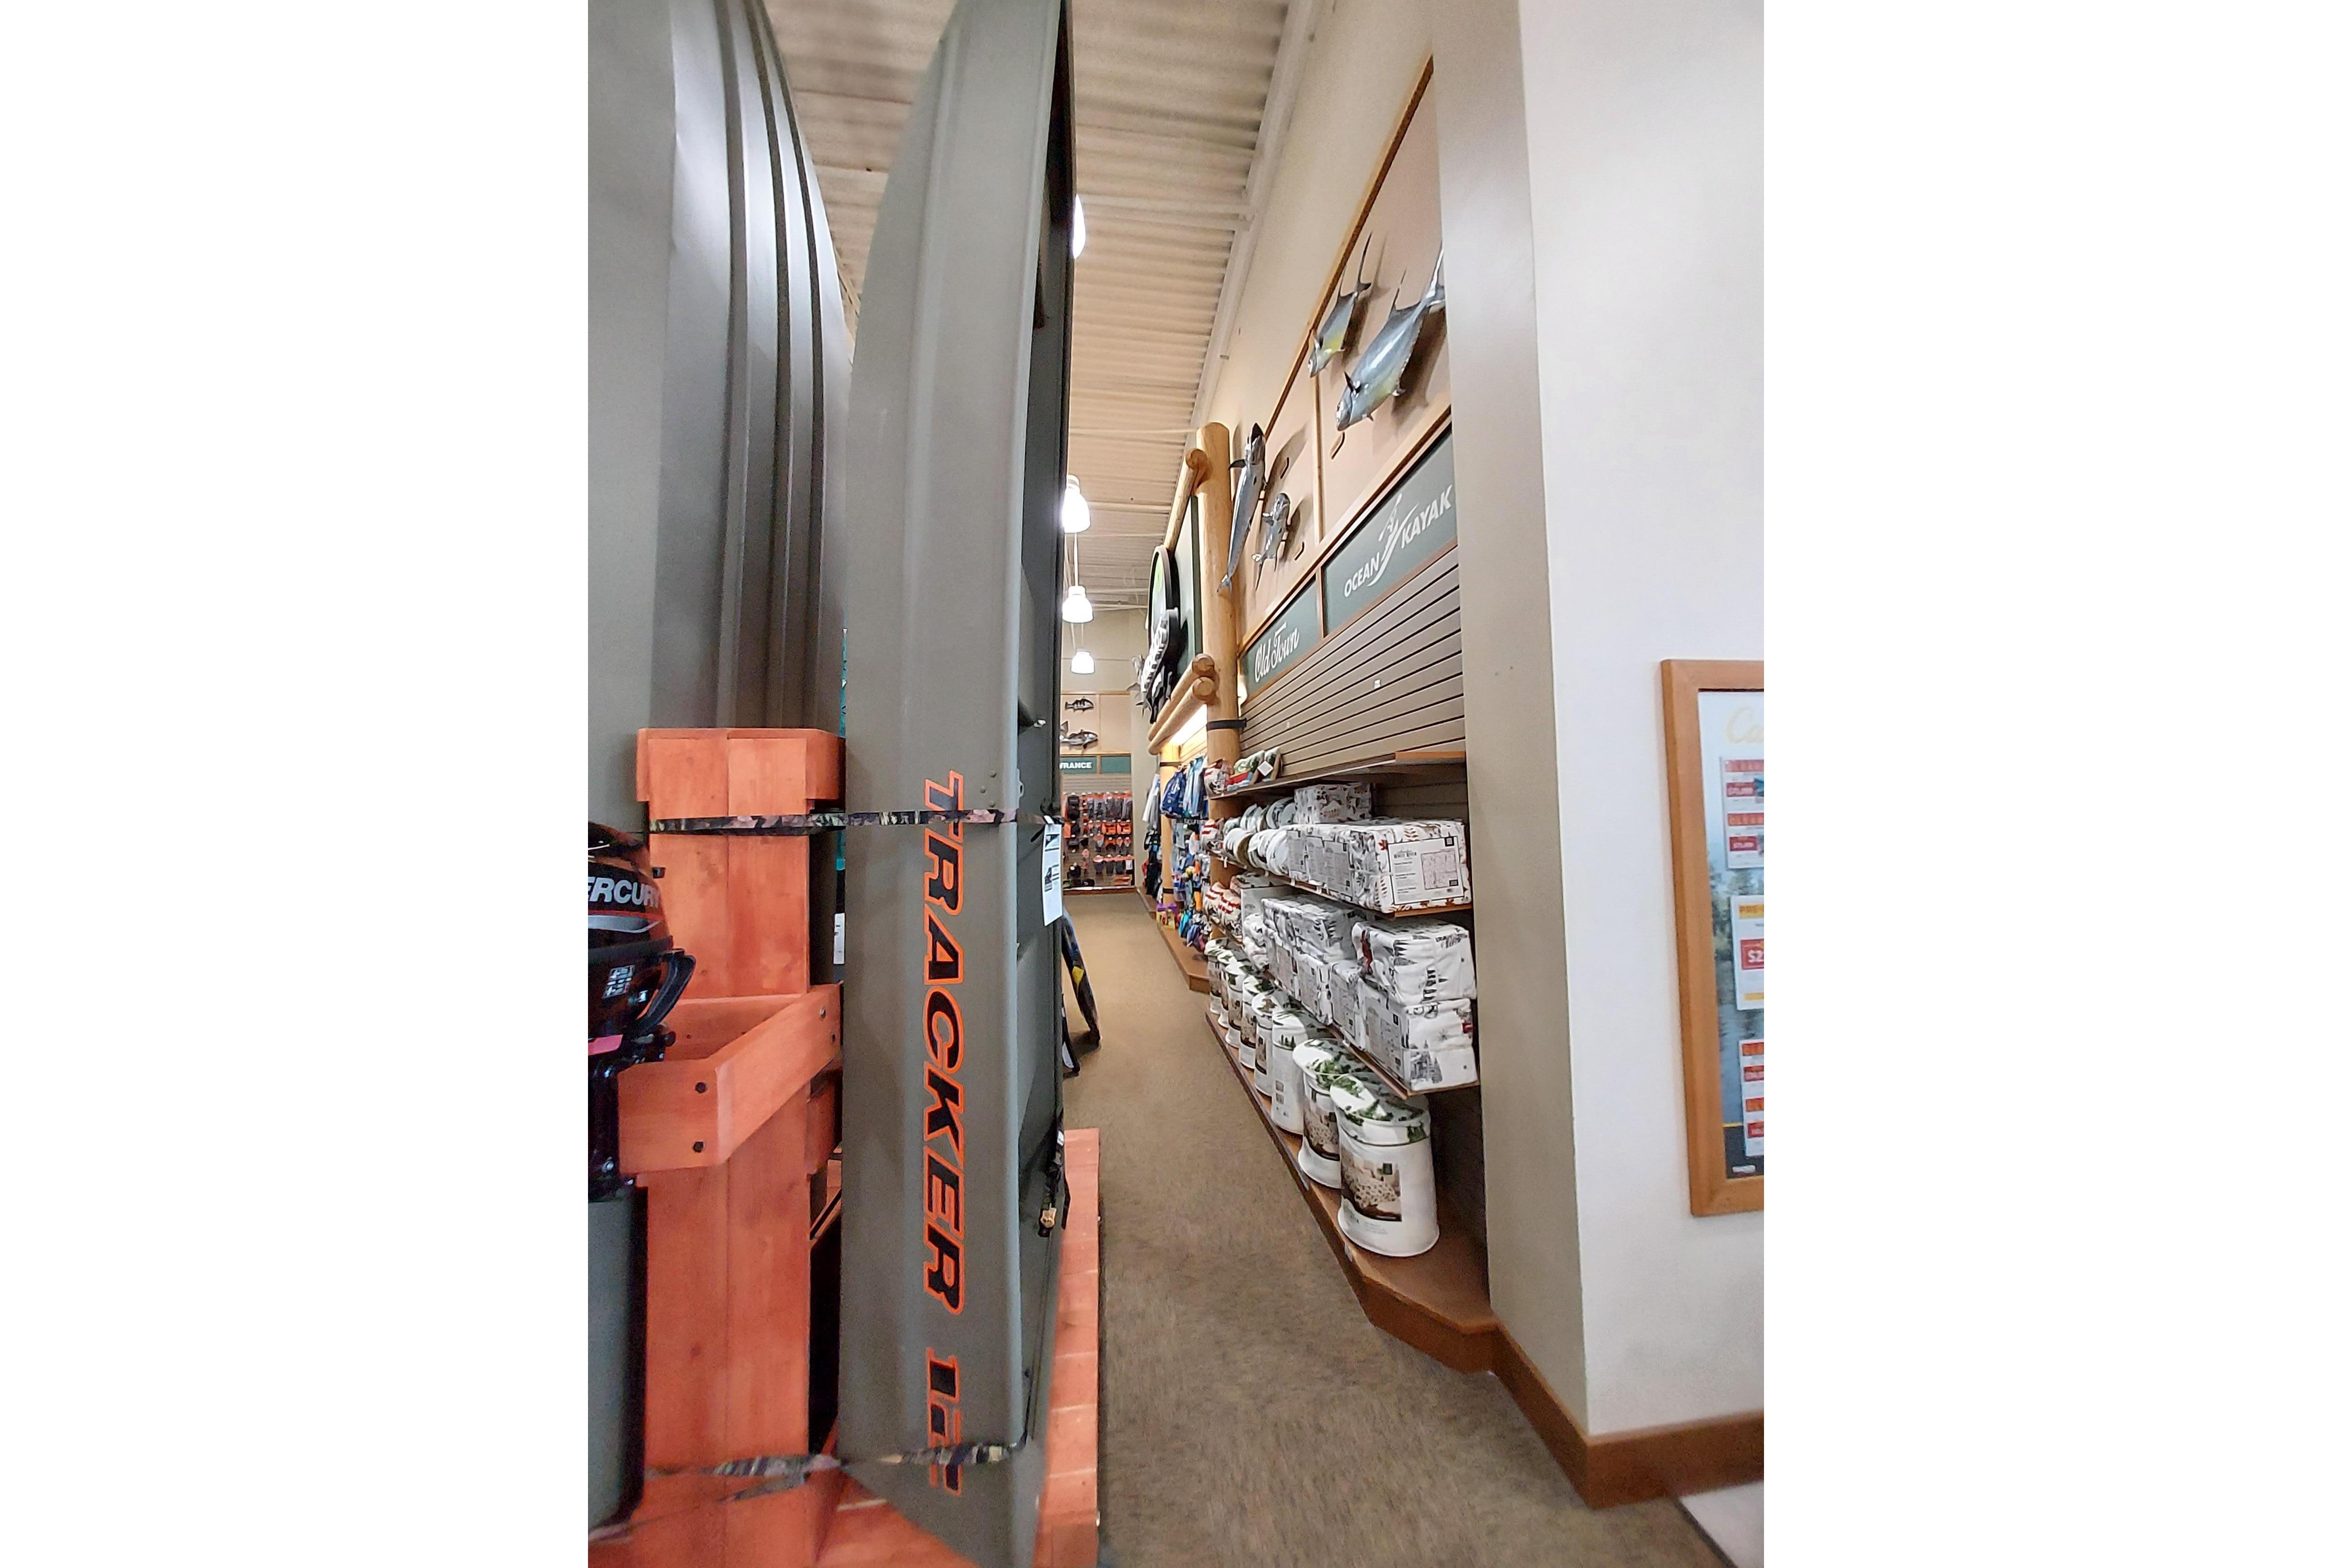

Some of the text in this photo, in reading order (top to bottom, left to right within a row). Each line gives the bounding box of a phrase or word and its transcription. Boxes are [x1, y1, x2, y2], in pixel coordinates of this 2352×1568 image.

[1344, 484, 1453, 598] OCEAN KAYAK
[1254, 622, 1300, 683] Old Town
[924, 770, 964, 1315] TRACKER
